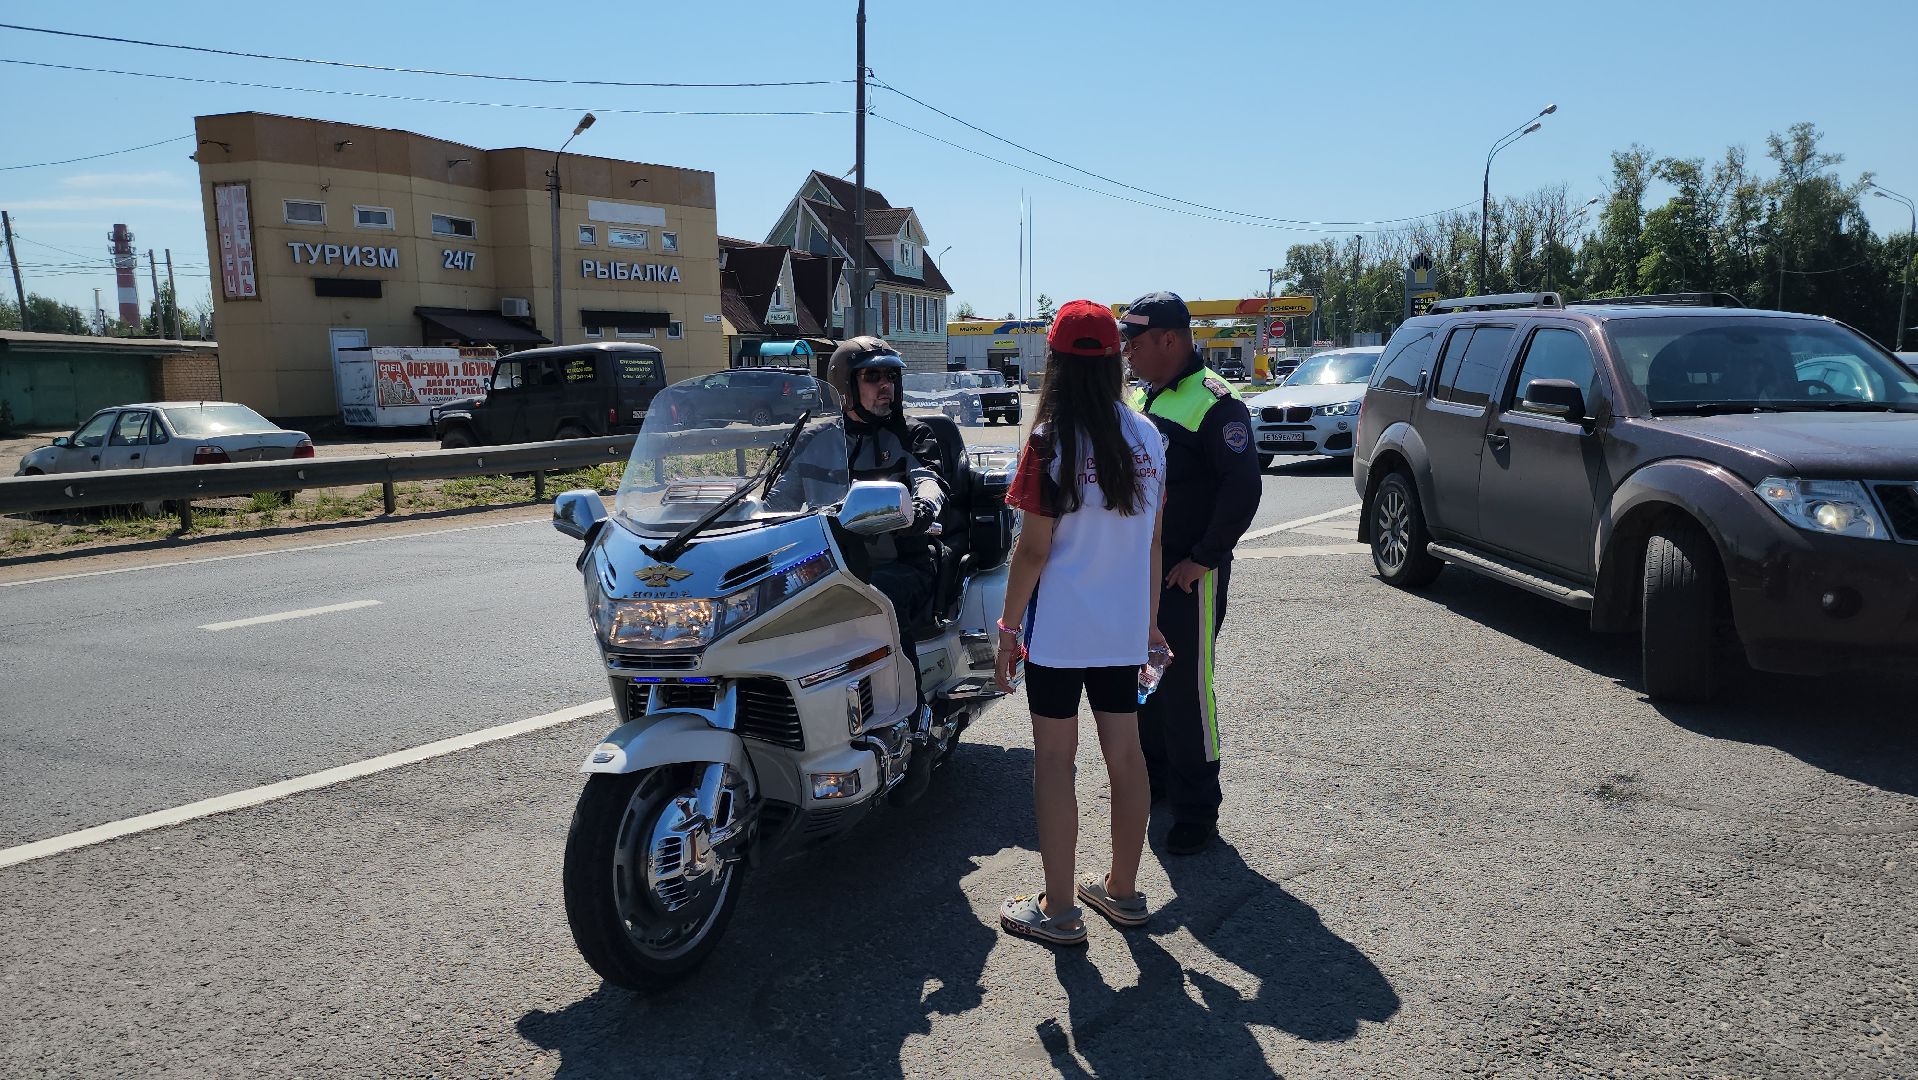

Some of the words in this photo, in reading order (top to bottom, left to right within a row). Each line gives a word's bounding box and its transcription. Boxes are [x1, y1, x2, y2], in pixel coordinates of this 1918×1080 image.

[287, 242, 399, 268] ТУРИЗМ
[442, 249, 476, 271] 24/7
[581, 258, 681, 283] РЫБАЛКА
[380, 363, 401, 373] СПЕЦ
[406, 361, 450, 378] ОДЕЖДА
[462, 361, 495, 377] ОБУВЬ
[461, 386, 486, 395] РАБОТ
